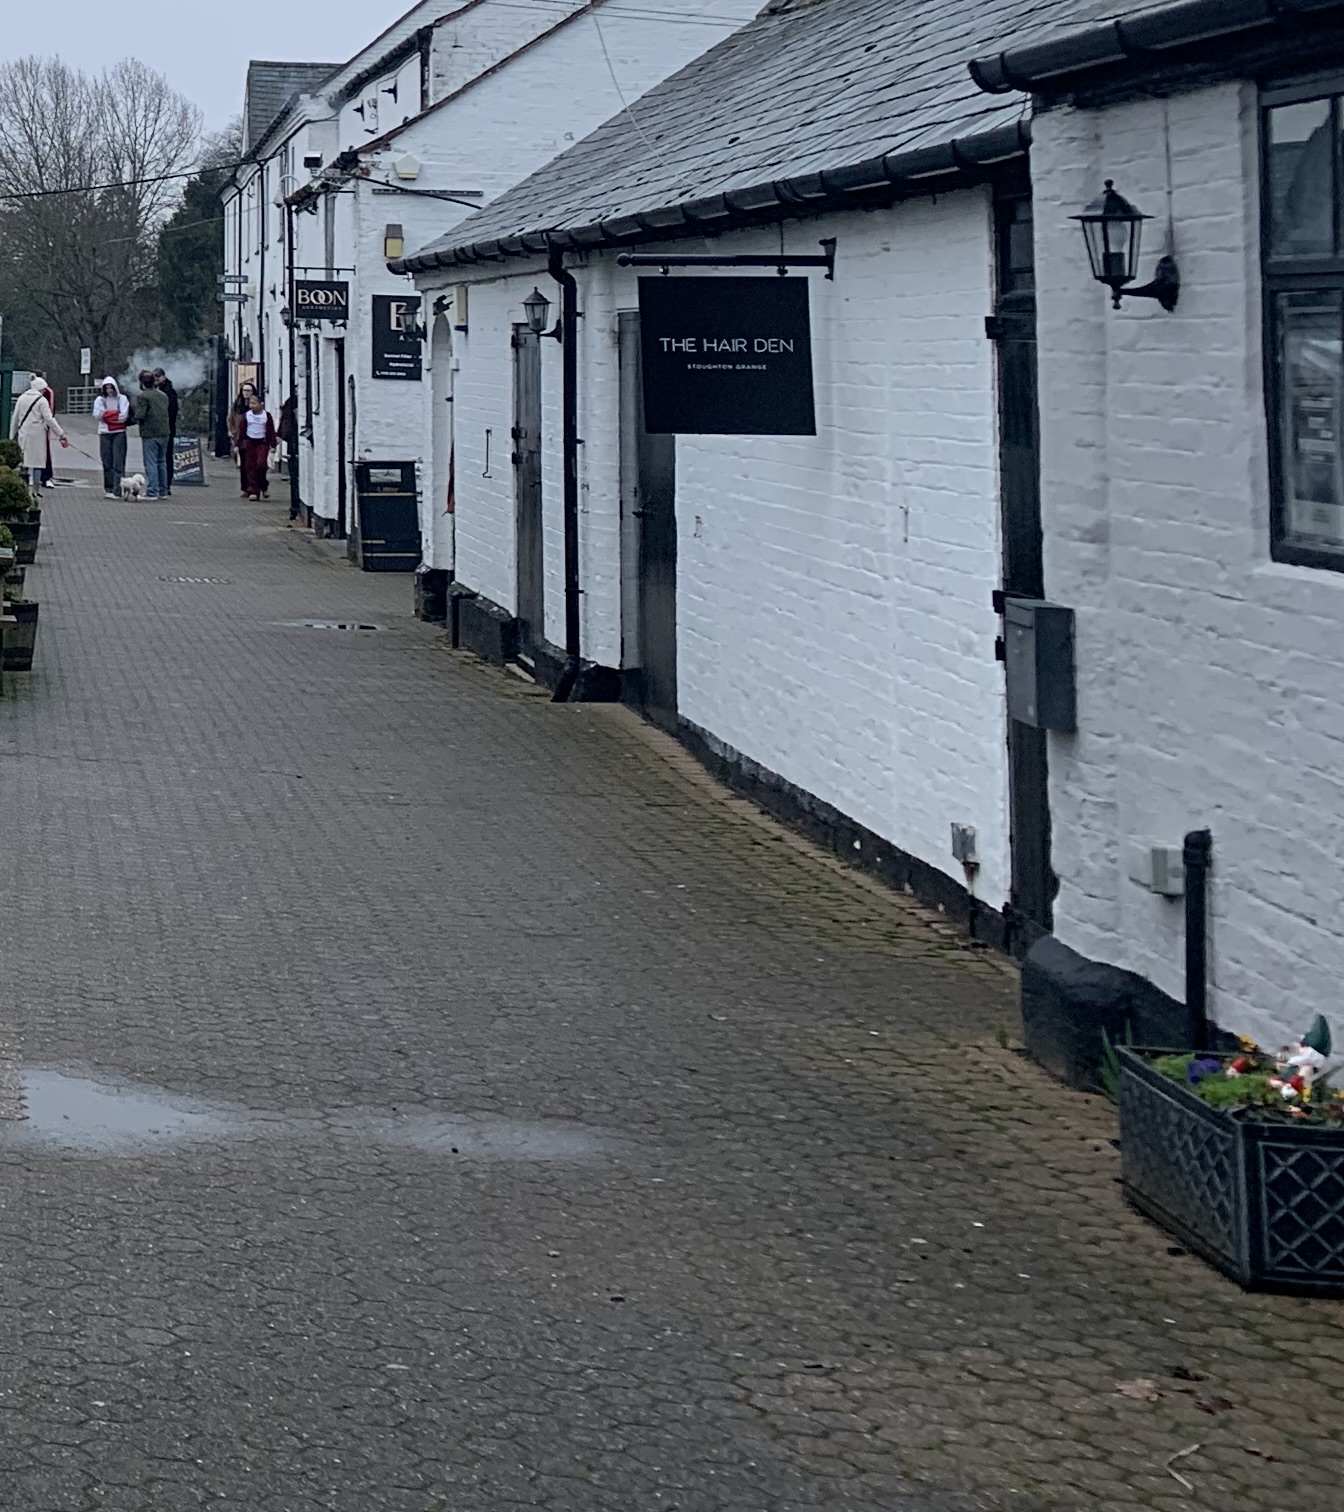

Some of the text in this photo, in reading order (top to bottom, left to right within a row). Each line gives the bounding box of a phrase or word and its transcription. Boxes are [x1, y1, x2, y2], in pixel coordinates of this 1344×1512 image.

[297, 288, 347, 306] BOON
[659, 338, 794, 353] THE HAIR DEN
[735, 363, 767, 371] GRANGE
